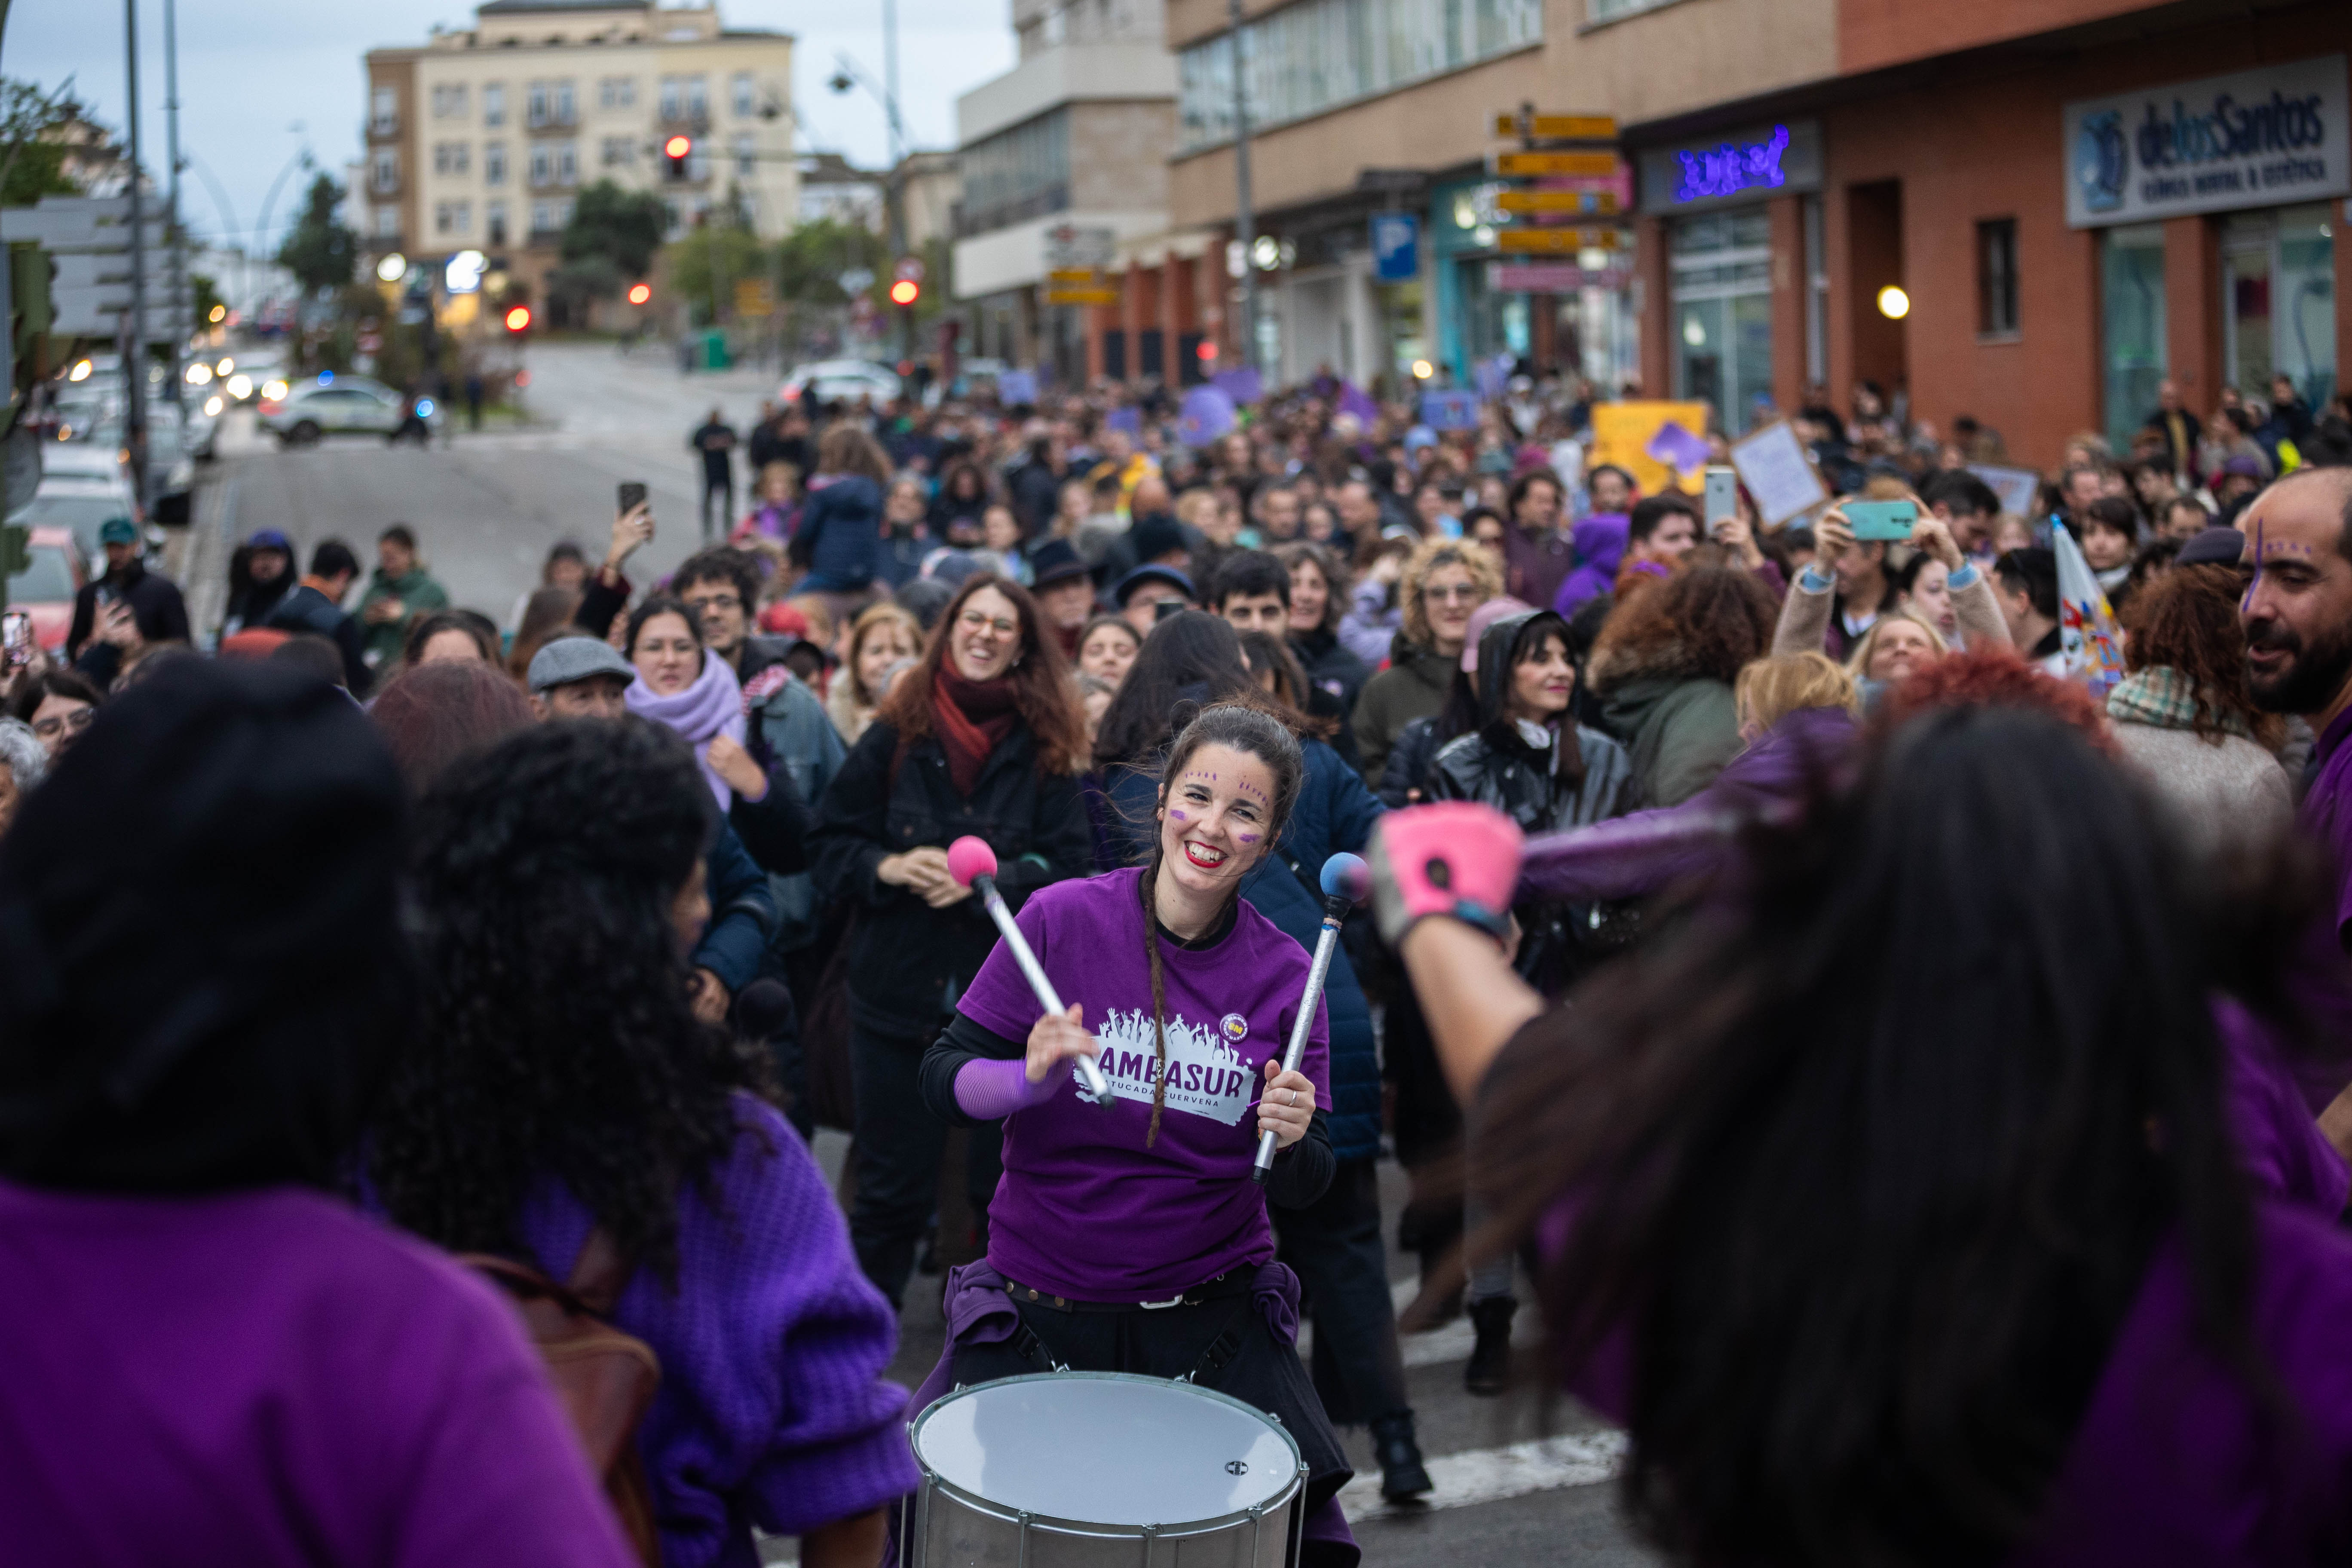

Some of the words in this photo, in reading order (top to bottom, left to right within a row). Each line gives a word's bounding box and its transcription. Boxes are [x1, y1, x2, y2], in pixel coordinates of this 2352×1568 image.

[1228, 1023, 1243, 1035] 8M
[1098, 1047, 1243, 1097] AMBASUR
[1105, 1080, 1155, 1095] TUCADA
